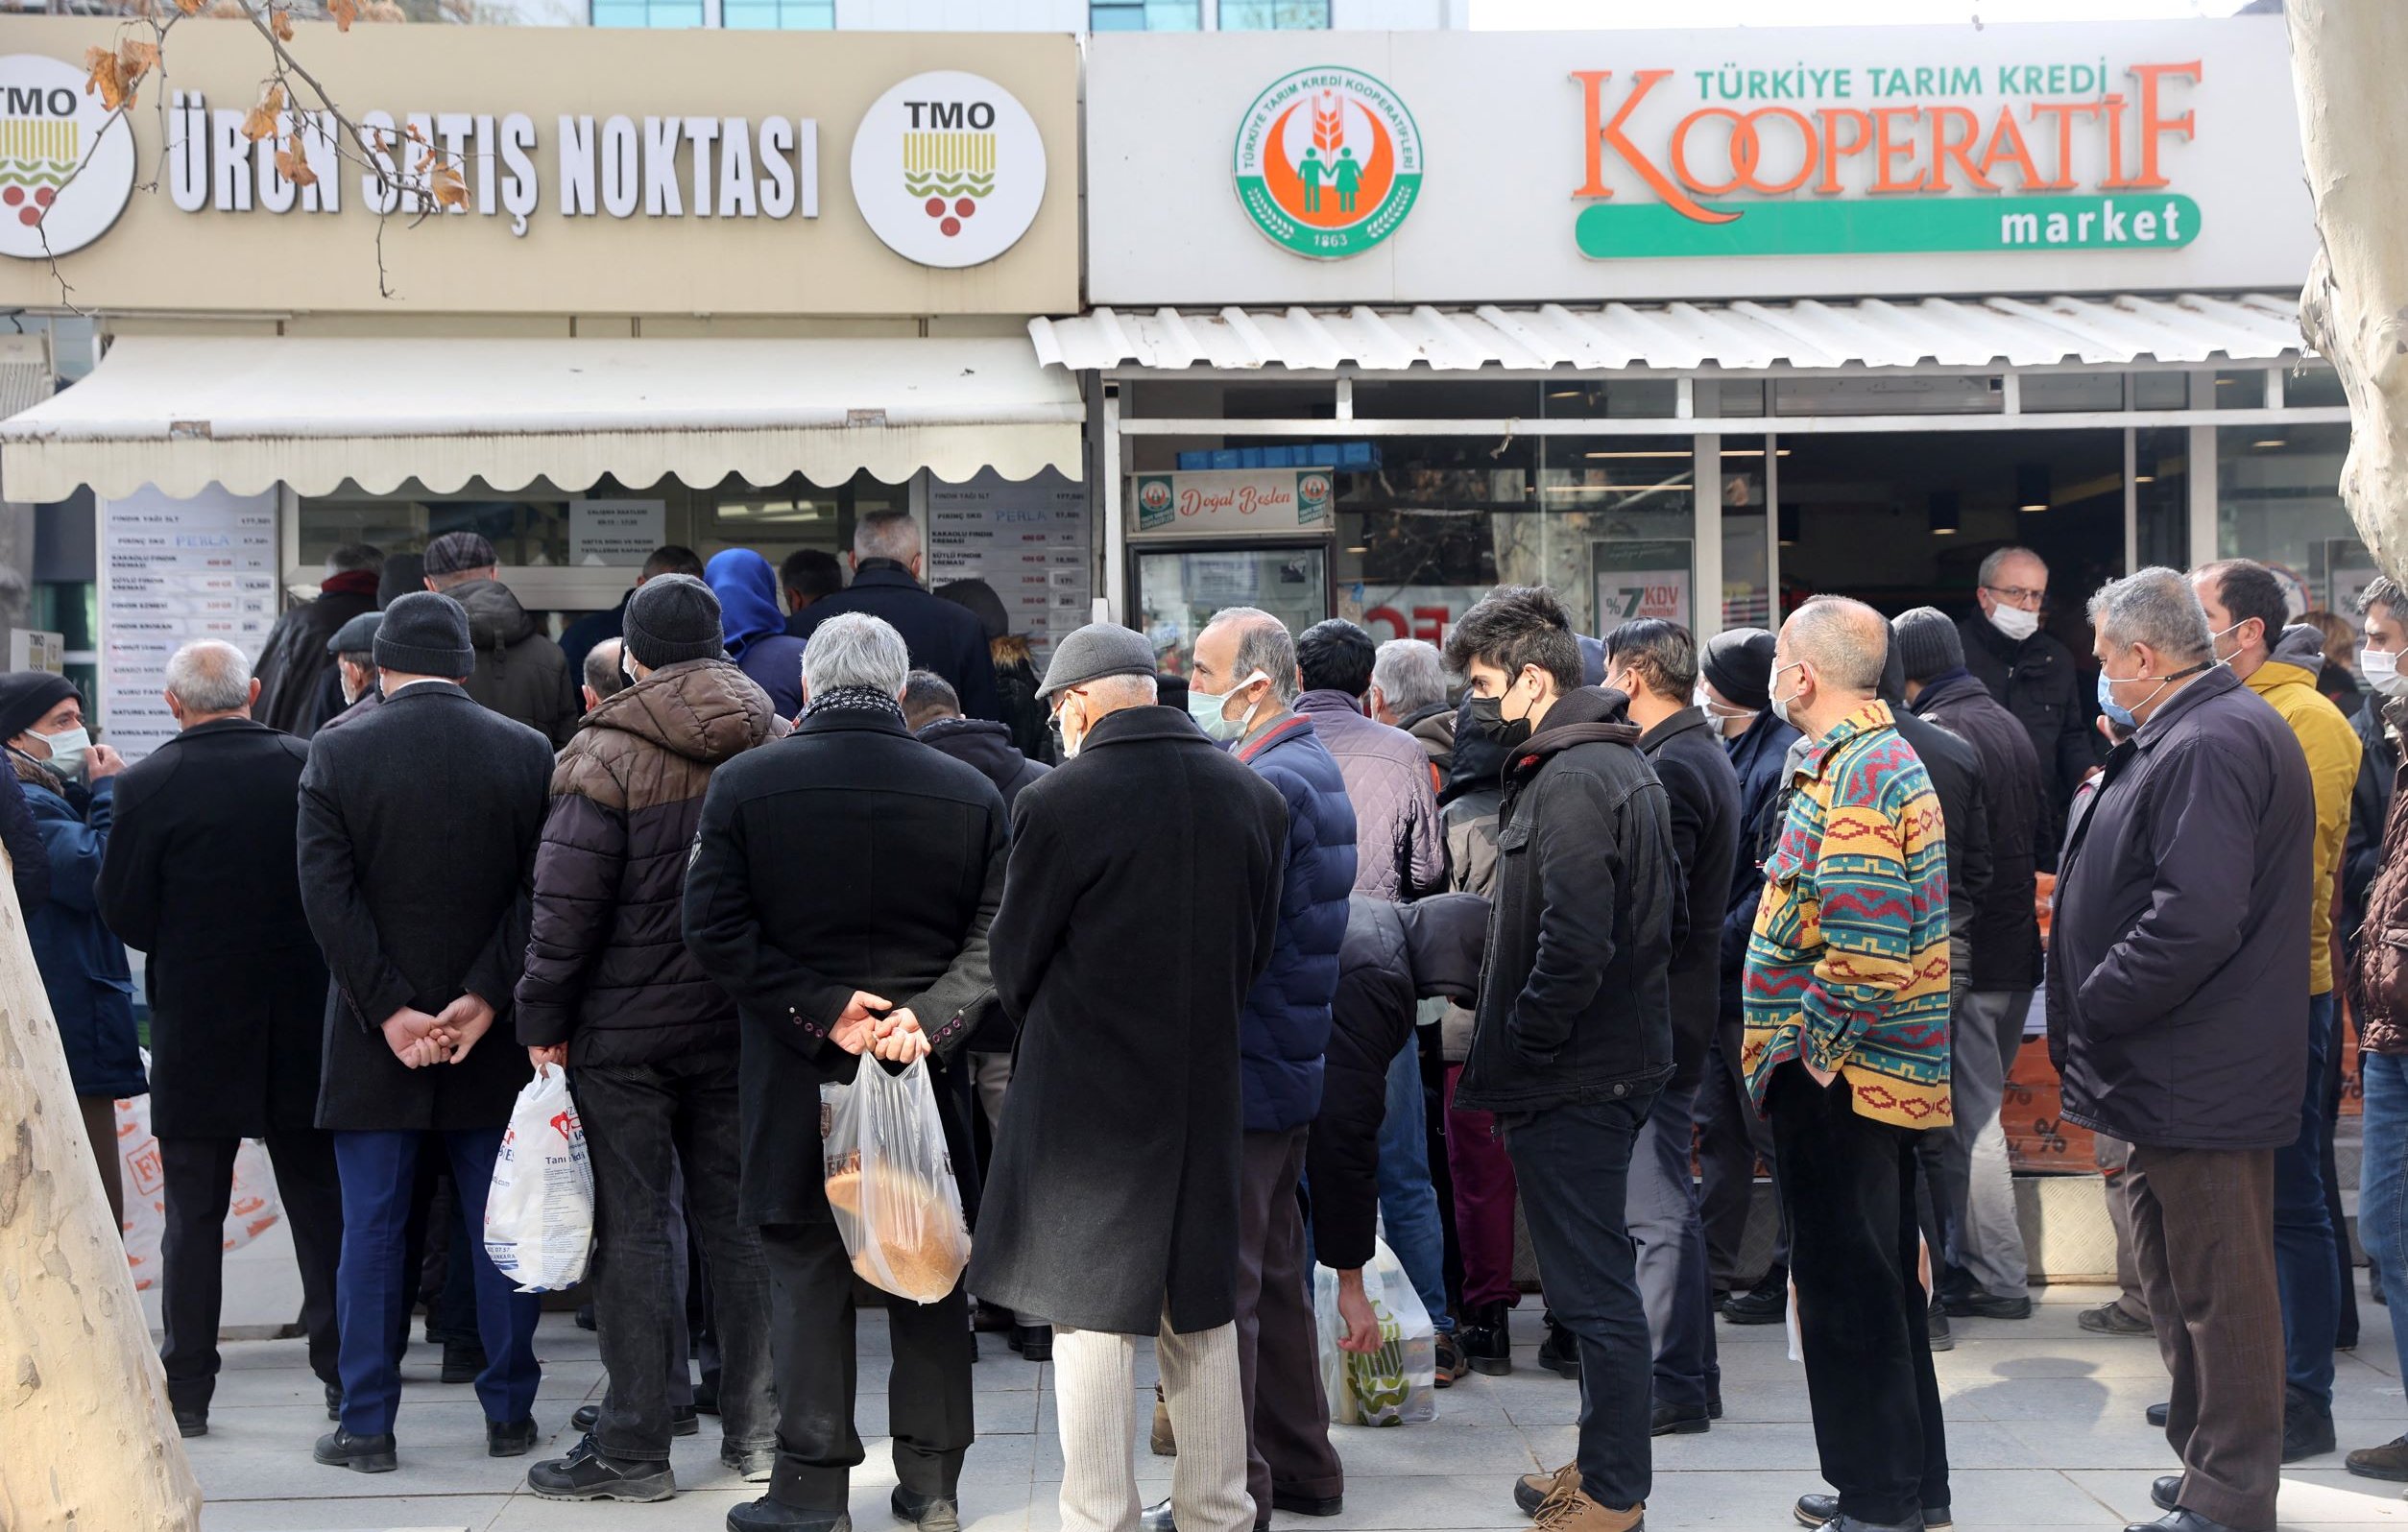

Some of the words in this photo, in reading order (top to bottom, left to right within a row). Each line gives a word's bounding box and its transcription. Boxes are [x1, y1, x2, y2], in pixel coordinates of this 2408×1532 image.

[1695, 61, 1851, 100] TÜRKİYE
[1866, 66, 1983, 98] TARIM
[1999, 57, 2107, 94] KREDİ
[0, 87, 77, 117] MO
[903, 101, 996, 130] TMO
[1242, 112, 1266, 169] TÜRKİYE
[1263, 83, 1299, 112] TARIM
[1302, 75, 1343, 89] KREDİ
[1344, 78, 1414, 169] KOOPERATİFLERİ
[1571, 60, 2202, 225] KOOPERATİF
[168, 88, 340, 214] ÜRÜN
[361, 109, 539, 237] SATIŞ
[558, 114, 819, 219] NOKTASI
[2001, 200, 2180, 244] market
[1313, 234, 1348, 248] 1863
[996, 510, 1047, 522] PERLA
[1180, 487, 1234, 516] Doğal
[1239, 486, 1290, 515] Beslen
[1645, 586, 1678, 606] KDV
